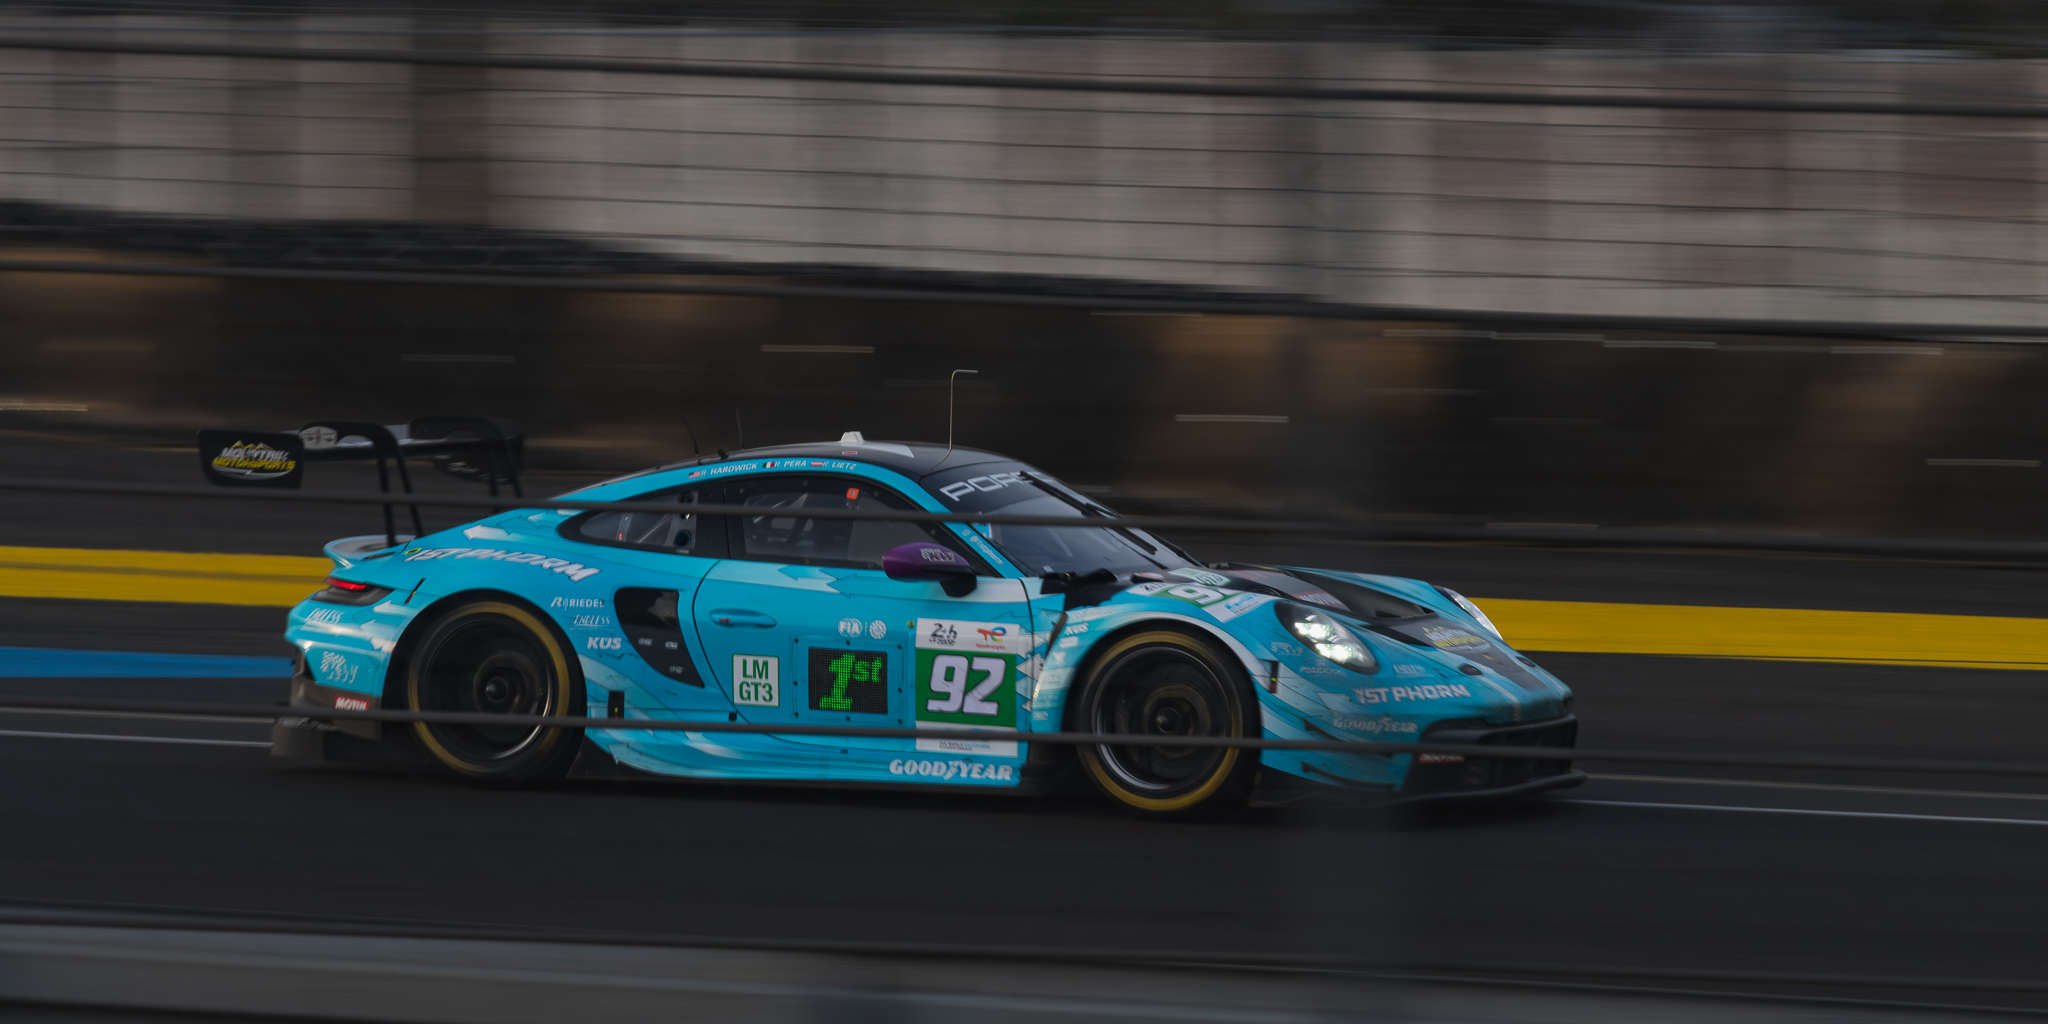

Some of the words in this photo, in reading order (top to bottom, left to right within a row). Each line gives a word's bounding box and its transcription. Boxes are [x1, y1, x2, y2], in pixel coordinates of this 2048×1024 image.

[710, 462, 757, 475] HARDWICK
[783, 460, 807, 468] PERA
[832, 461, 857, 470] LIETZ
[569, 598, 605, 608] RIEDEL
[742, 659, 769, 679] LM
[739, 681, 773, 702] GT3
[819, 653, 882, 711] 1st
[926, 654, 1007, 716] 92
[889, 758, 1014, 781] GOODYEAR
